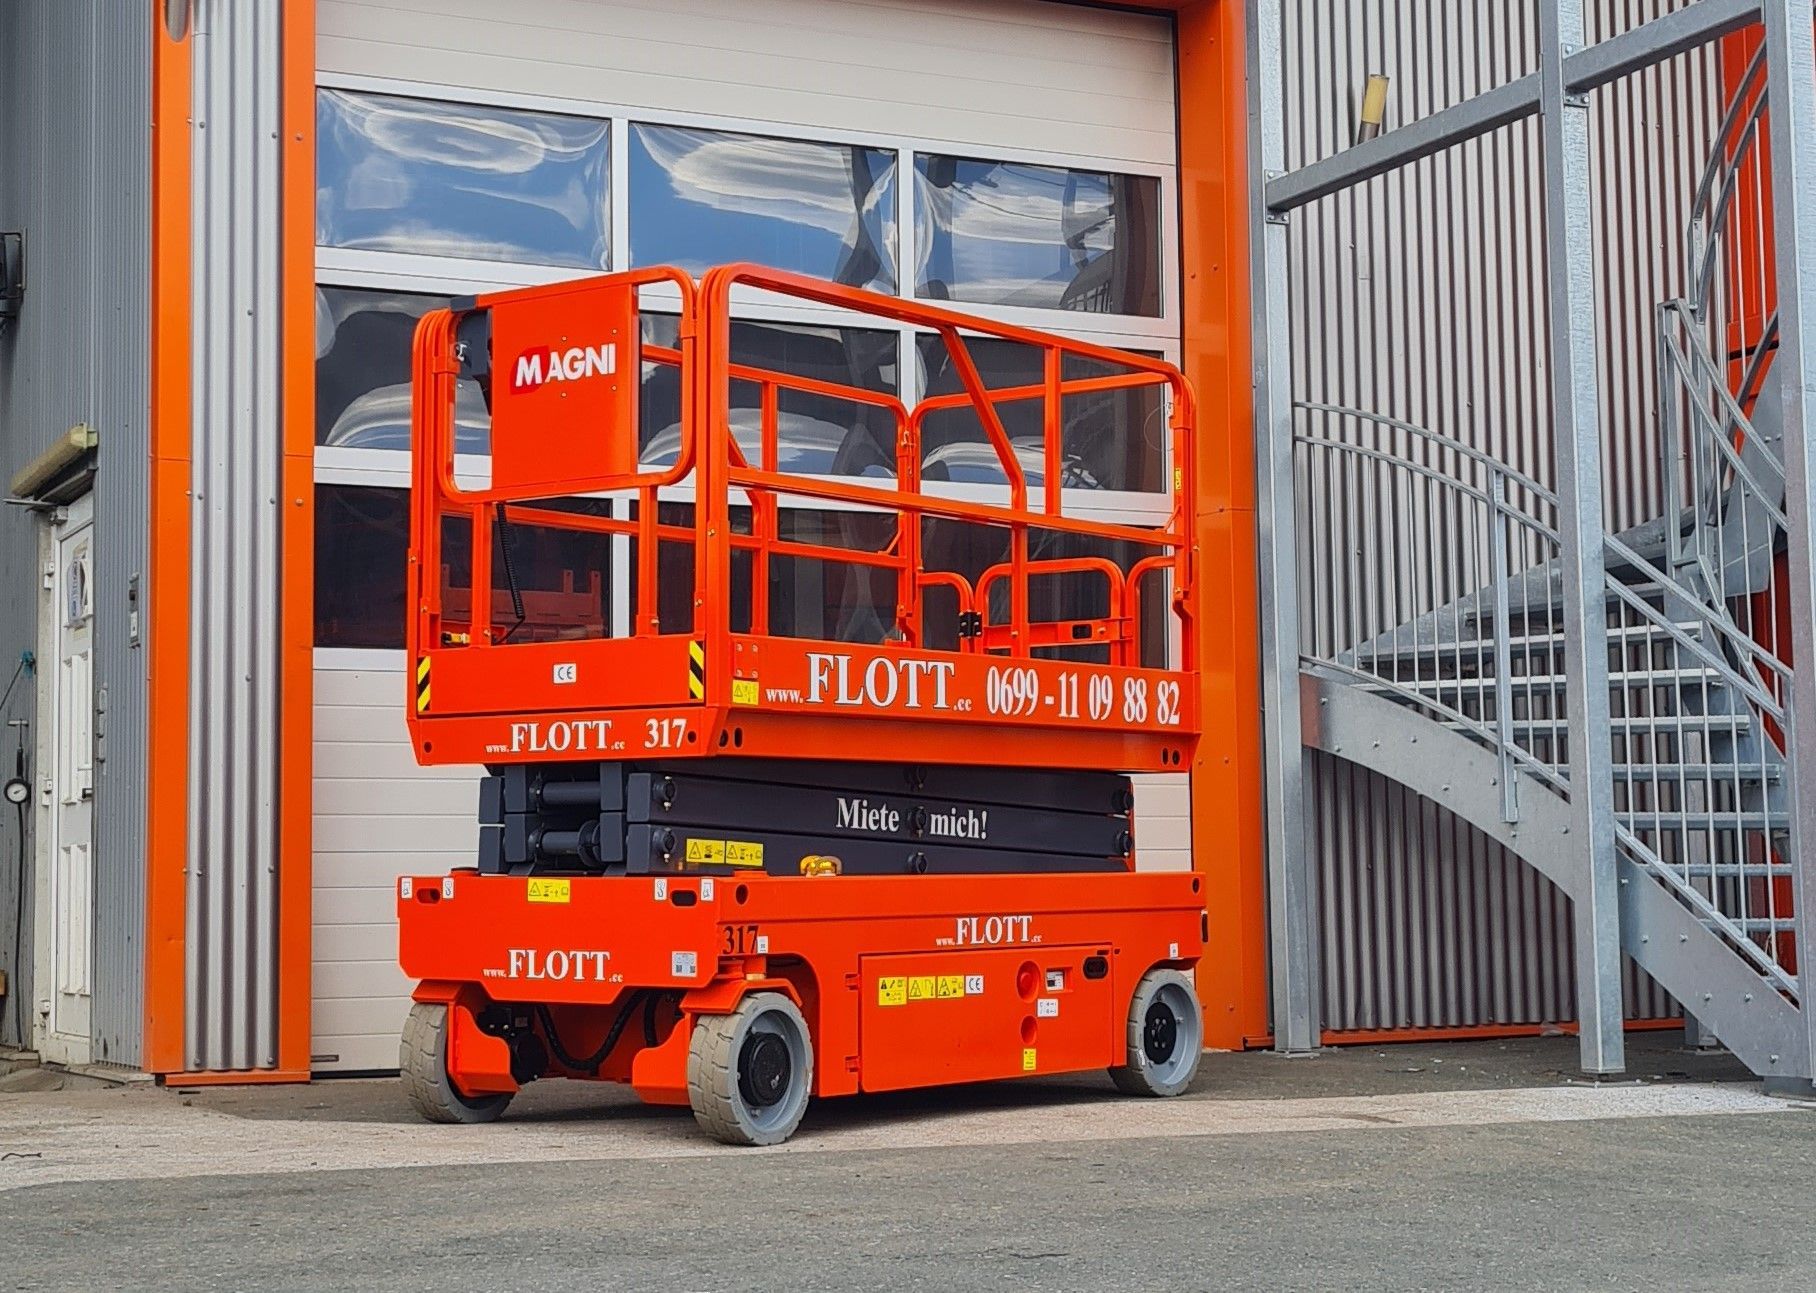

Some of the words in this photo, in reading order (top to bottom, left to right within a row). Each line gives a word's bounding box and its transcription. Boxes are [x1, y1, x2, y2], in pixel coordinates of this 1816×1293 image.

[515, 342, 616, 387] MAGNI
[557, 666, 574, 681] CE
[765, 652, 973, 713] www.FLOTT.cc
[986, 665, 1039, 717] 0699
[1044, 694, 1055, 706] -
[1057, 671, 1080, 719] 11
[1088, 674, 1114, 721] 09
[1122, 676, 1148, 724] 88
[1156, 679, 1182, 726] 82
[485, 719, 626, 753] www.FLOTT.cc
[644, 717, 688, 749] 317
[835, 796, 900, 834] Miete
[929, 807, 989, 840] mich!
[722, 924, 760, 955] 317
[968, 977, 982, 992] CE
